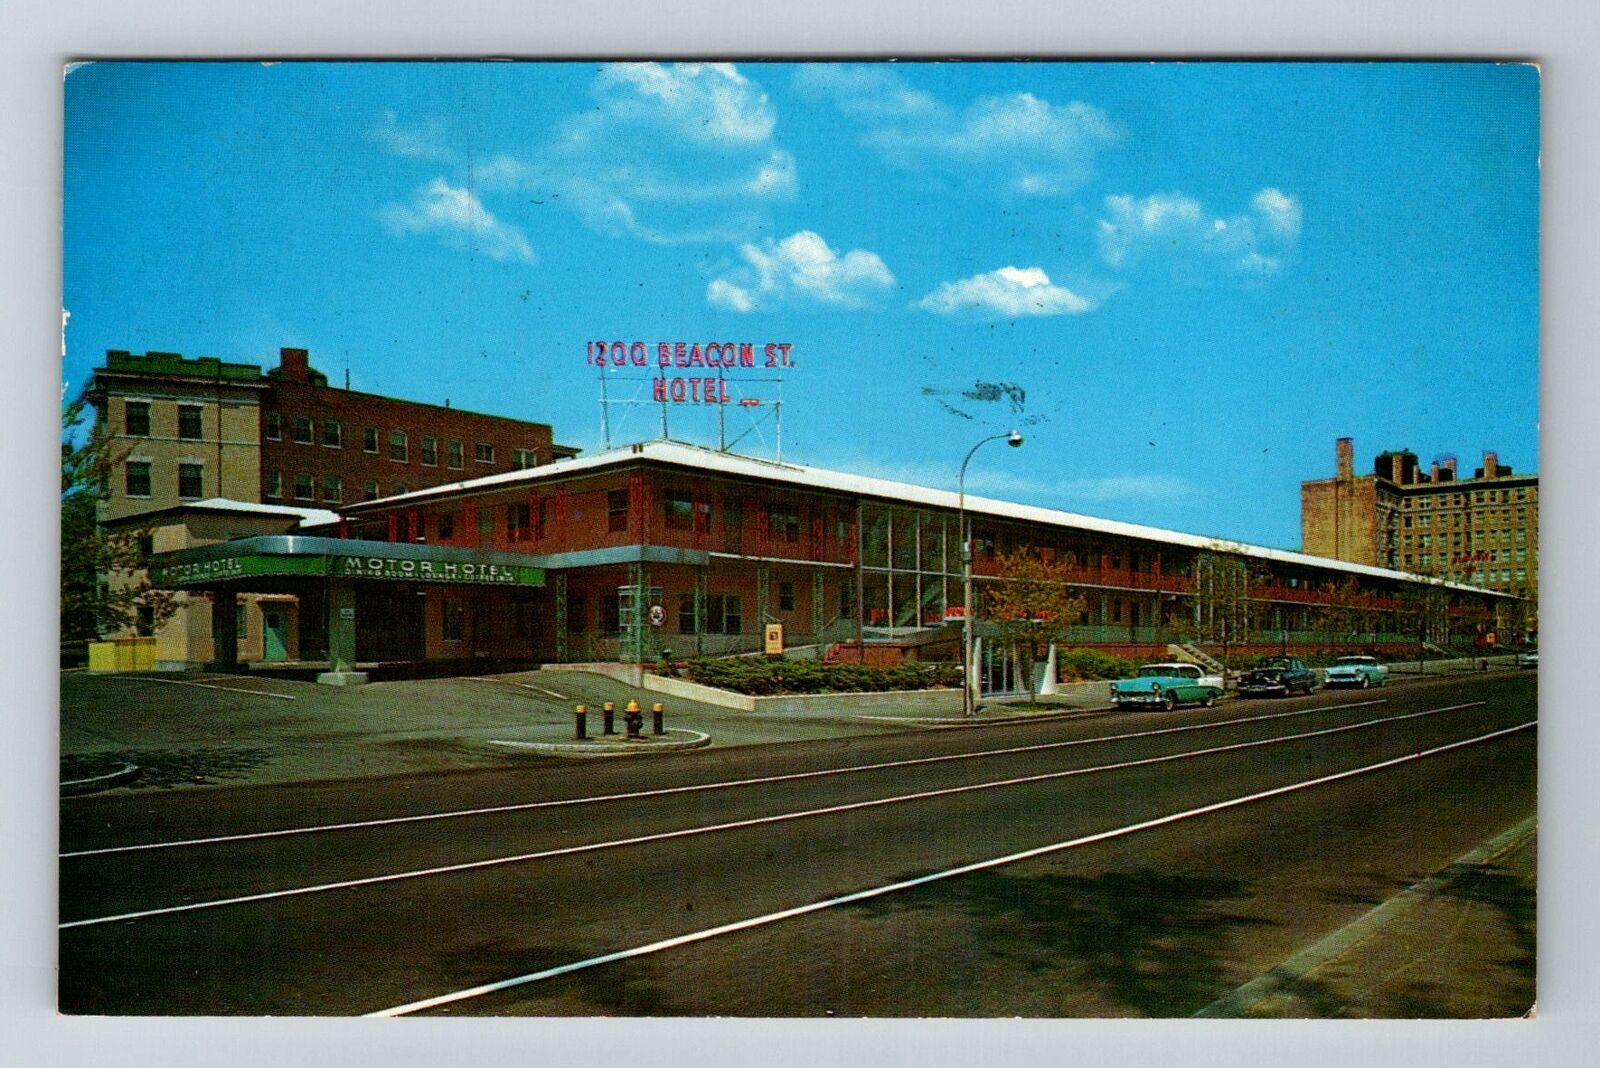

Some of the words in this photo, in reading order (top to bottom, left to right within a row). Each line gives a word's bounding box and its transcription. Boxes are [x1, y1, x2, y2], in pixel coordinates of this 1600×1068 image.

[586, 340, 648, 367] 1200
[658, 342, 755, 368] BEACON
[764, 343, 796, 368] ST.
[653, 377, 731, 403] HOTEL
[204, 558, 241, 571] HOTEL
[345, 557, 433, 572] MOTOR
[444, 562, 512, 576] HOTEL
